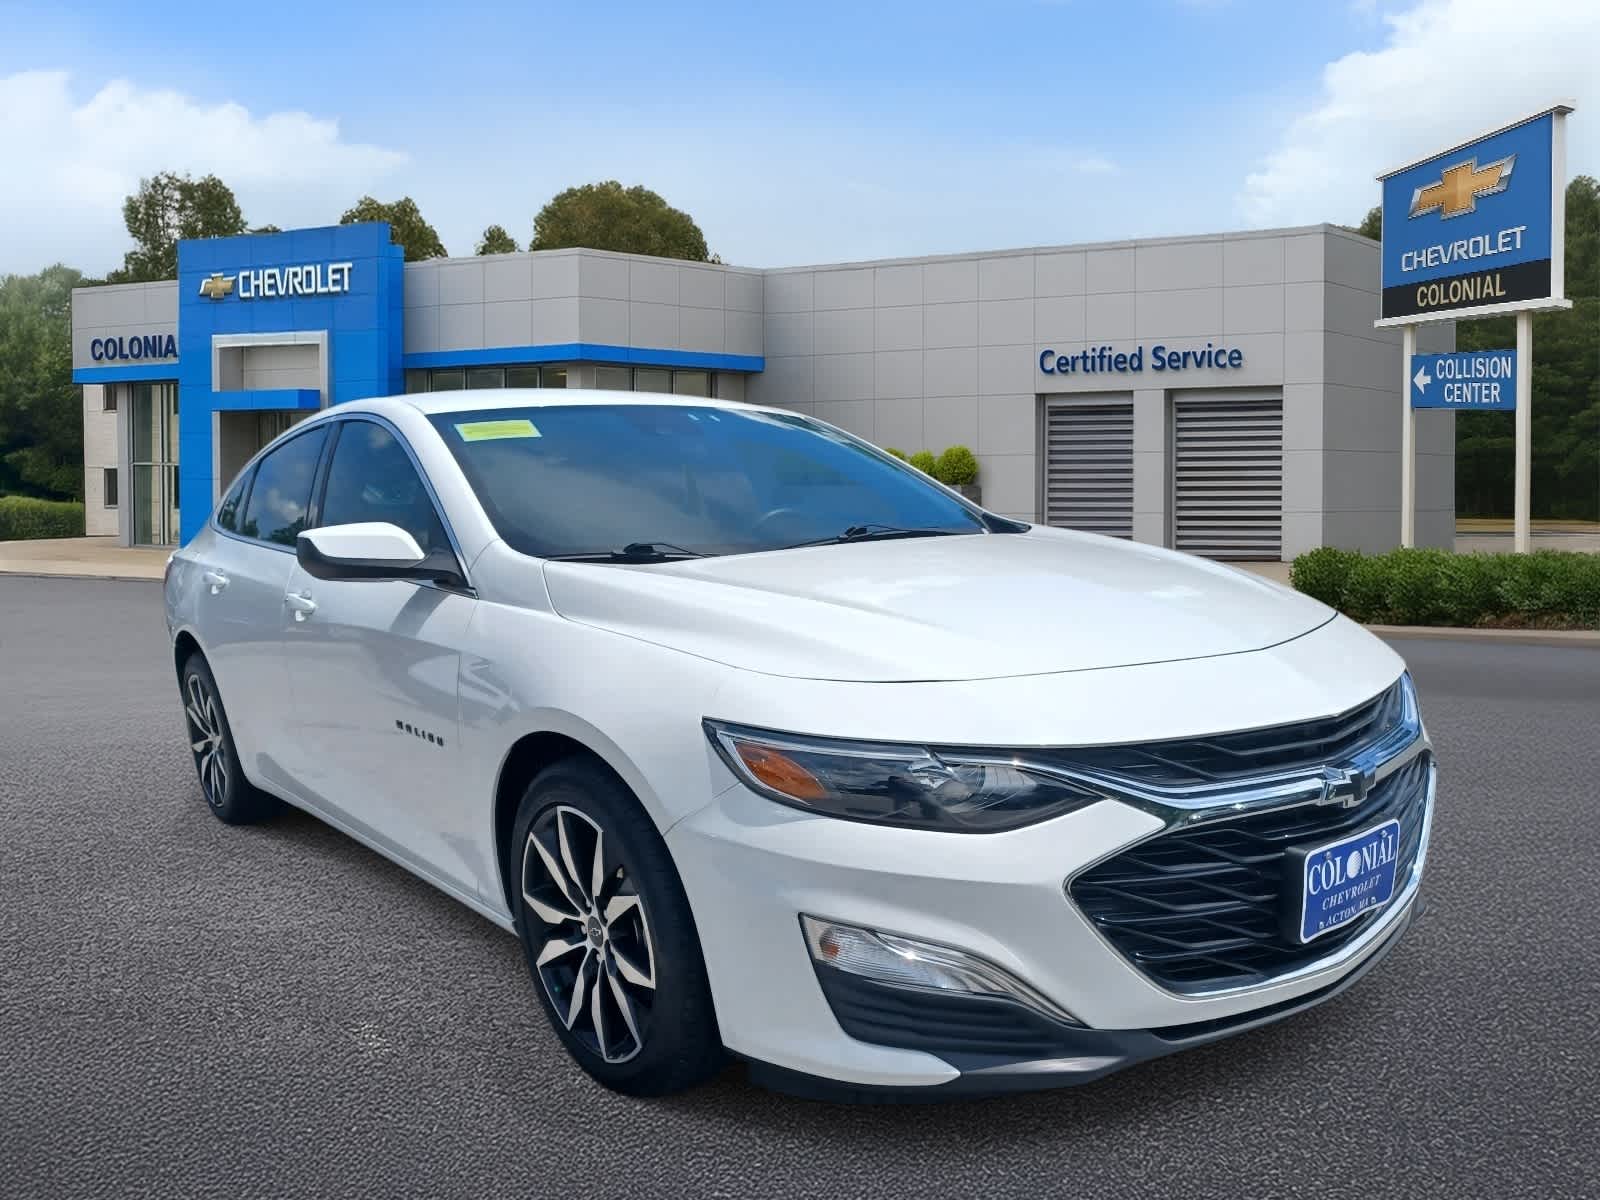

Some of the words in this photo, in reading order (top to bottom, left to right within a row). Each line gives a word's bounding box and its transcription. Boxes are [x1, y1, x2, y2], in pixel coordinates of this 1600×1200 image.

[1401, 225, 1527, 272] CHEVROLET
[238, 262, 353, 299] CHEVROLET
[1416, 273, 1506, 307] COLONIAL
[90, 334, 178, 361] COLONIA
[1039, 345, 1144, 375] Certified
[1151, 343, 1243, 371] Service
[1435, 356, 1512, 379] COLLISION
[1443, 382, 1501, 403] CENTER
[1322, 874, 1382, 910] CHEVROLET
